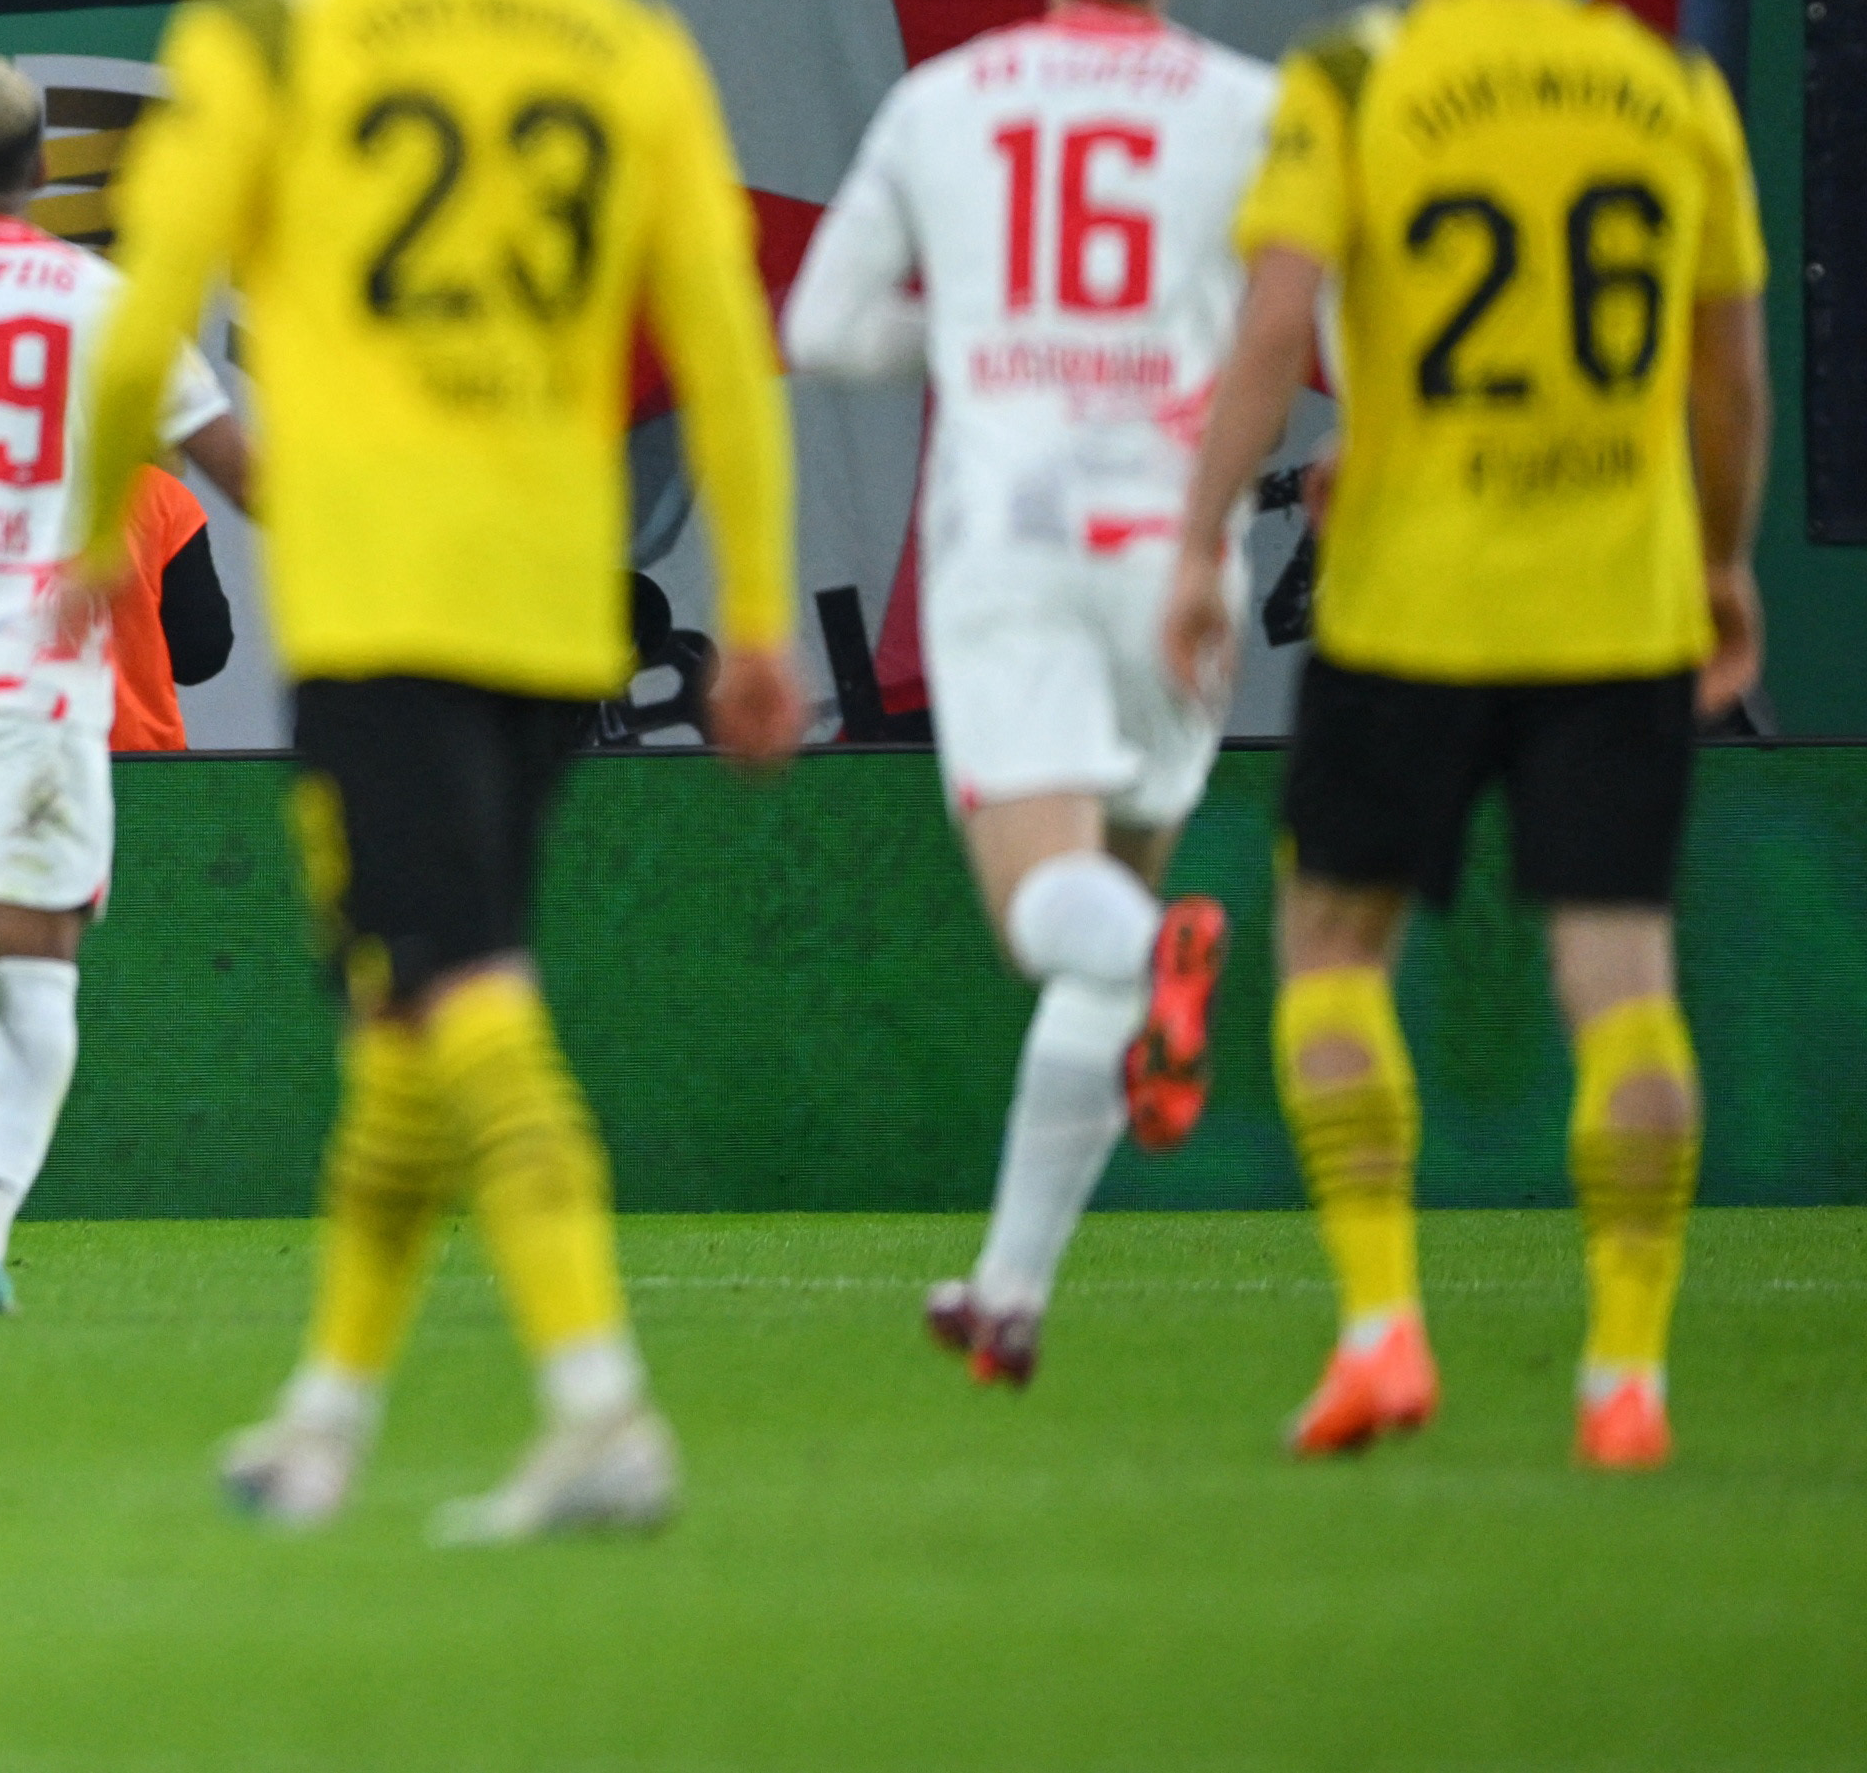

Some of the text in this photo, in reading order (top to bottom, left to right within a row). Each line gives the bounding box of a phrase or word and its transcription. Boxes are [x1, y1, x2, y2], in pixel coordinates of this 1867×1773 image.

[357, 86, 613, 326] 23
[991, 117, 1157, 316] 16
[1406, 181, 1665, 398] 26
